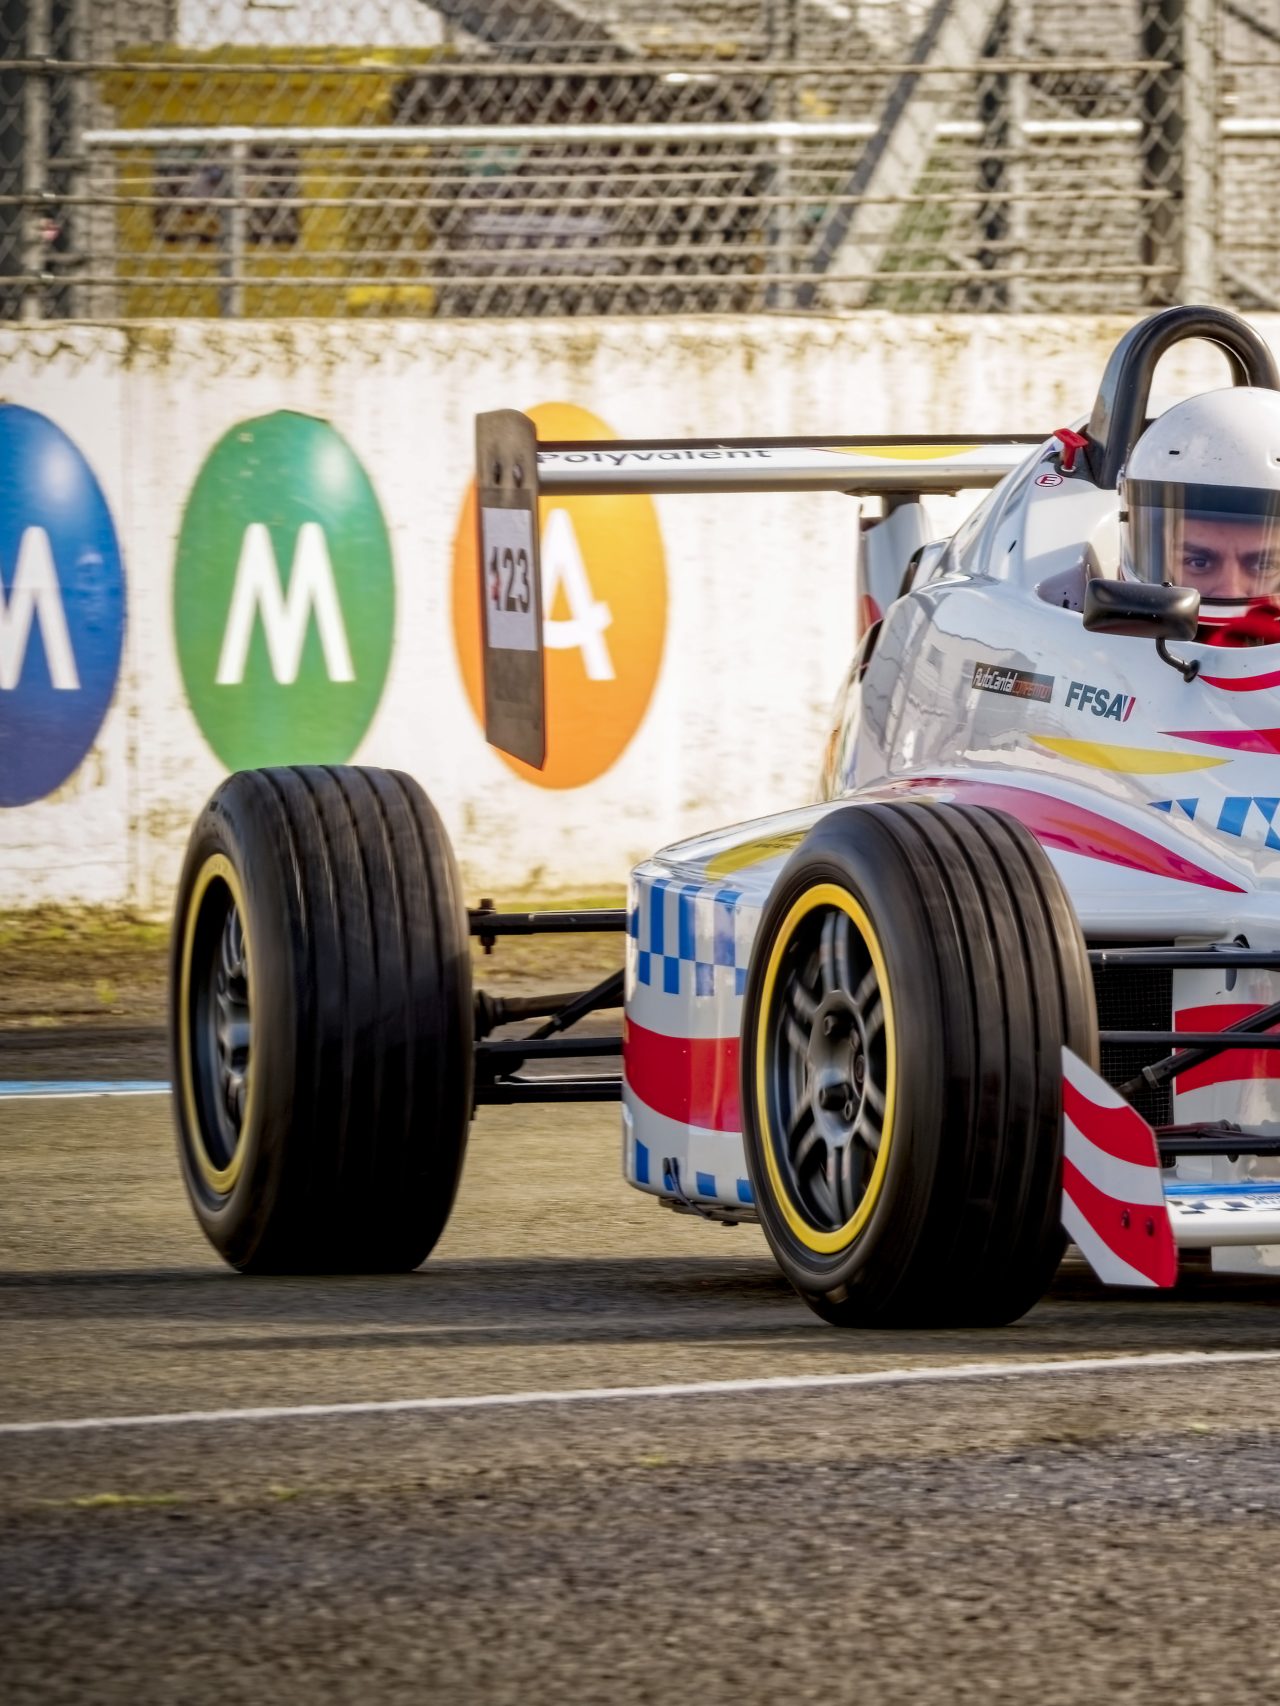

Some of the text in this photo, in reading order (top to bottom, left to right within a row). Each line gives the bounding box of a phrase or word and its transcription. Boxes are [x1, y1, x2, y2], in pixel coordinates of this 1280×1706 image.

[536, 449, 772, 466] Polyvalent
[214, 522, 357, 685] M
[541, 508, 618, 682] A
[1065, 681, 1127, 721] FFSA
